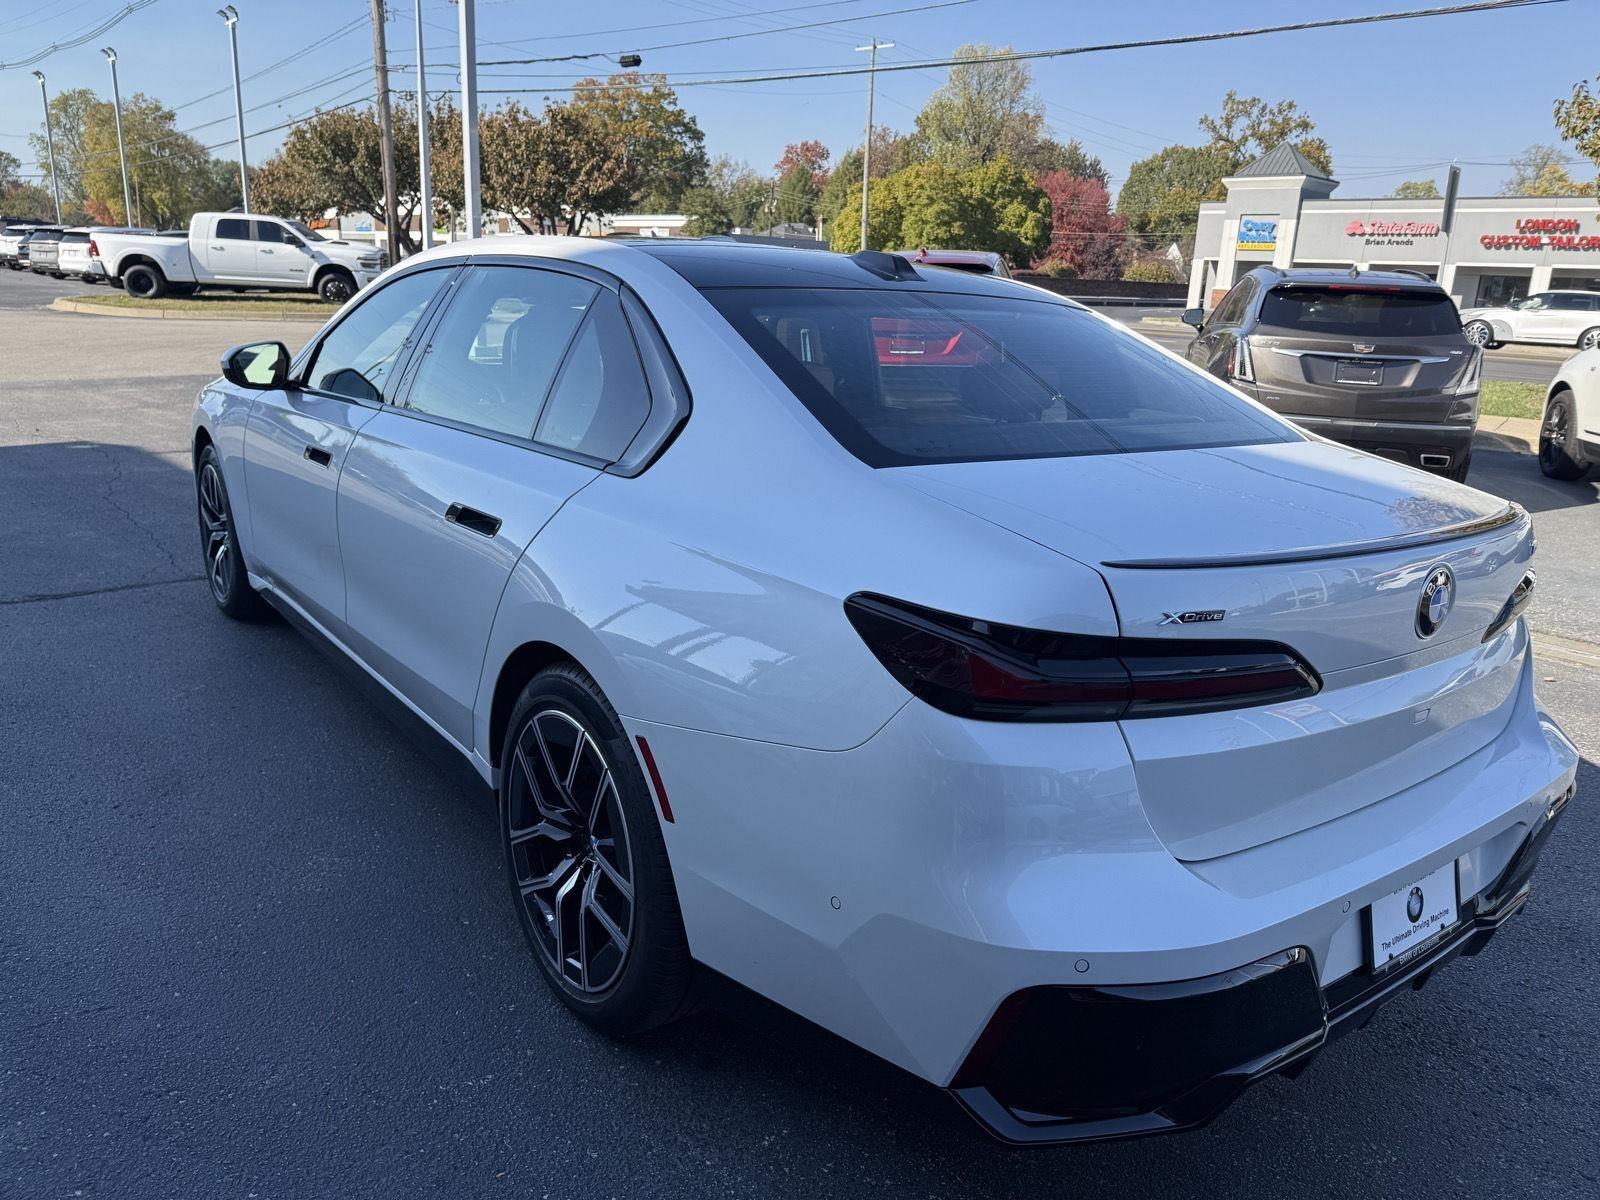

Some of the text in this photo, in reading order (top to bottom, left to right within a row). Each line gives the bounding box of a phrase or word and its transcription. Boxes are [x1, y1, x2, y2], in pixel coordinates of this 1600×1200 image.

[1515, 219, 1580, 234] LONDON
[1480, 234, 1543, 250] CUSTOM
[1381, 908, 1449, 952] The Ultimate Driving Machine
[1400, 951, 1412, 965] BMW
